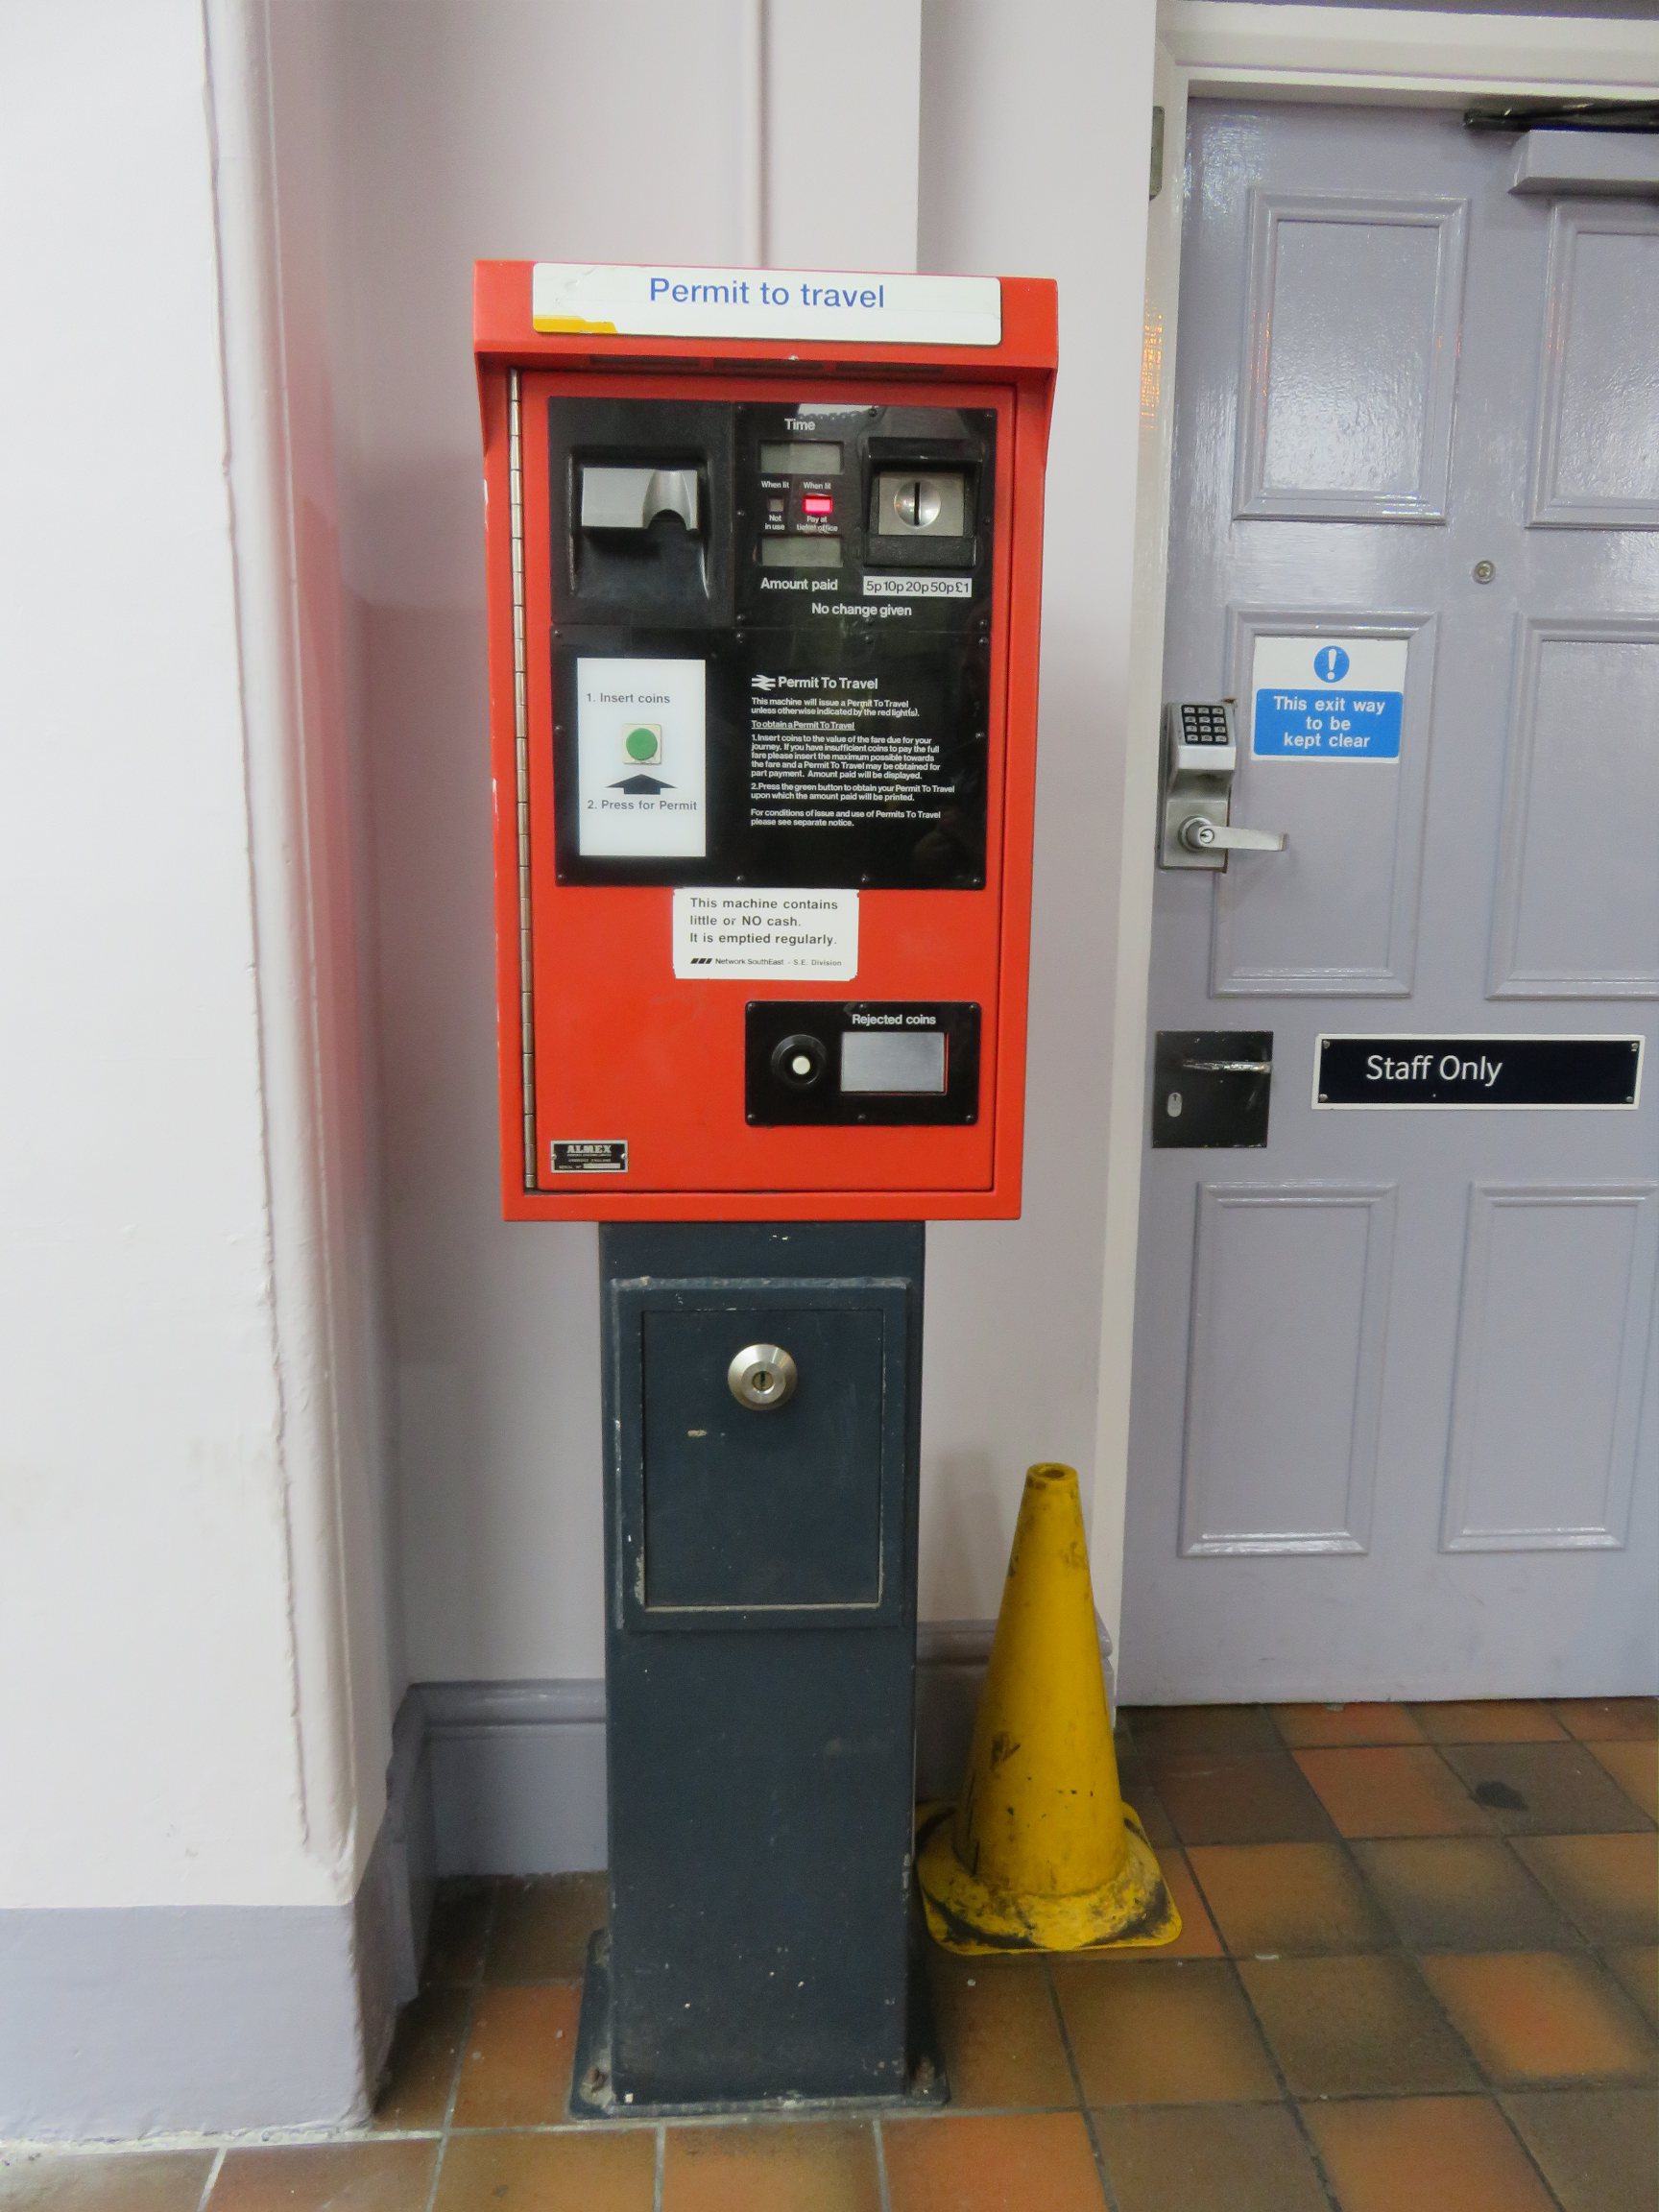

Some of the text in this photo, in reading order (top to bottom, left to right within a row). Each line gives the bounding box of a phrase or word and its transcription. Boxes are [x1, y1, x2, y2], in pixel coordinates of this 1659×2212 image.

[650, 277, 885, 307] Permit to travel
[784, 418, 815, 430] Time
[761, 480, 789, 489] When lit
[804, 481, 823, 490] When
[806, 516, 819, 524] Pay
[760, 577, 838, 592] Amount paid
[866, 580, 969, 595] 5p 10p 20p 50p £1
[811, 602, 912, 617] No change given
[779, 676, 878, 688] Permit To Travel
[587, 693, 670, 704] 1. Insert coins
[769, 697, 802, 706] machine
[819, 698, 839, 707] issue
[884, 699, 908, 708] Travel
[1274, 696, 1385, 714] This exit way
[778, 707, 816, 715] otherwise
[853, 708, 862, 717] by
[864, 708, 876, 716] the
[1306, 716, 1351, 731] to be
[1284, 733, 1370, 749] kept clear
[768, 752, 793, 761] please
[870, 754, 902, 762] possible
[751, 769, 767, 779] part
[839, 771, 856, 780] paid
[840, 793, 857, 802] paid
[588, 800, 697, 810] 2. Press for Permit
[751, 818, 776, 827] please
[793, 819, 827, 828] separate
[690, 898, 838, 909] This machine contains
[690, 915, 717, 926] little
[742, 916, 762, 926] NO
[767, 916, 801, 926] cash.
[690, 933, 837, 947] It is emptied regularly.
[853, 1014, 936, 1026] Rejected coins
[1366, 1054, 1503, 1087] Staff Only
[567, 1144, 612, 1154] ALMEX
